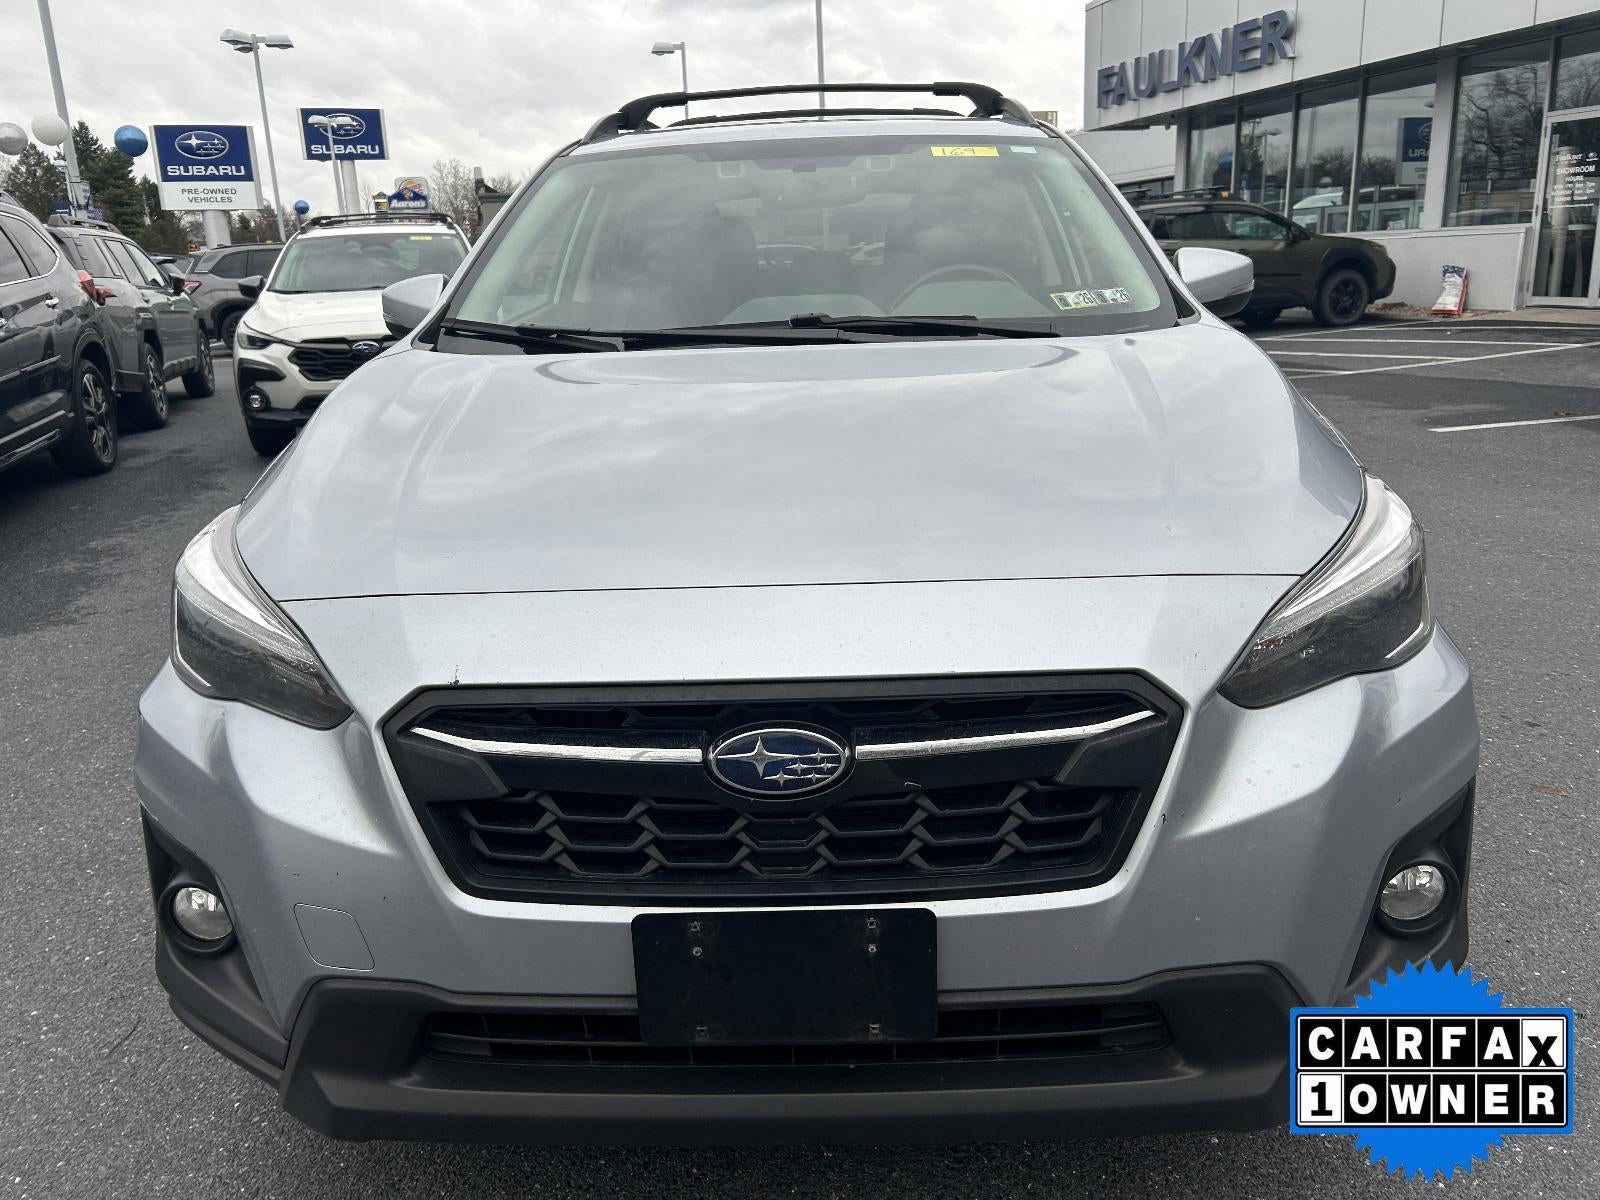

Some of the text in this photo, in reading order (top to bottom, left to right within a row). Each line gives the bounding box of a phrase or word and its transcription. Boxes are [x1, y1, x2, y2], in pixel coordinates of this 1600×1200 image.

[1097, 9, 1295, 109] FAULKNER
[310, 144, 380, 154] SUBARU
[166, 165, 246, 176] SUBARU
[1556, 165, 1595, 174] SHOWROOM
[1080, 292, 1094, 304] 26
